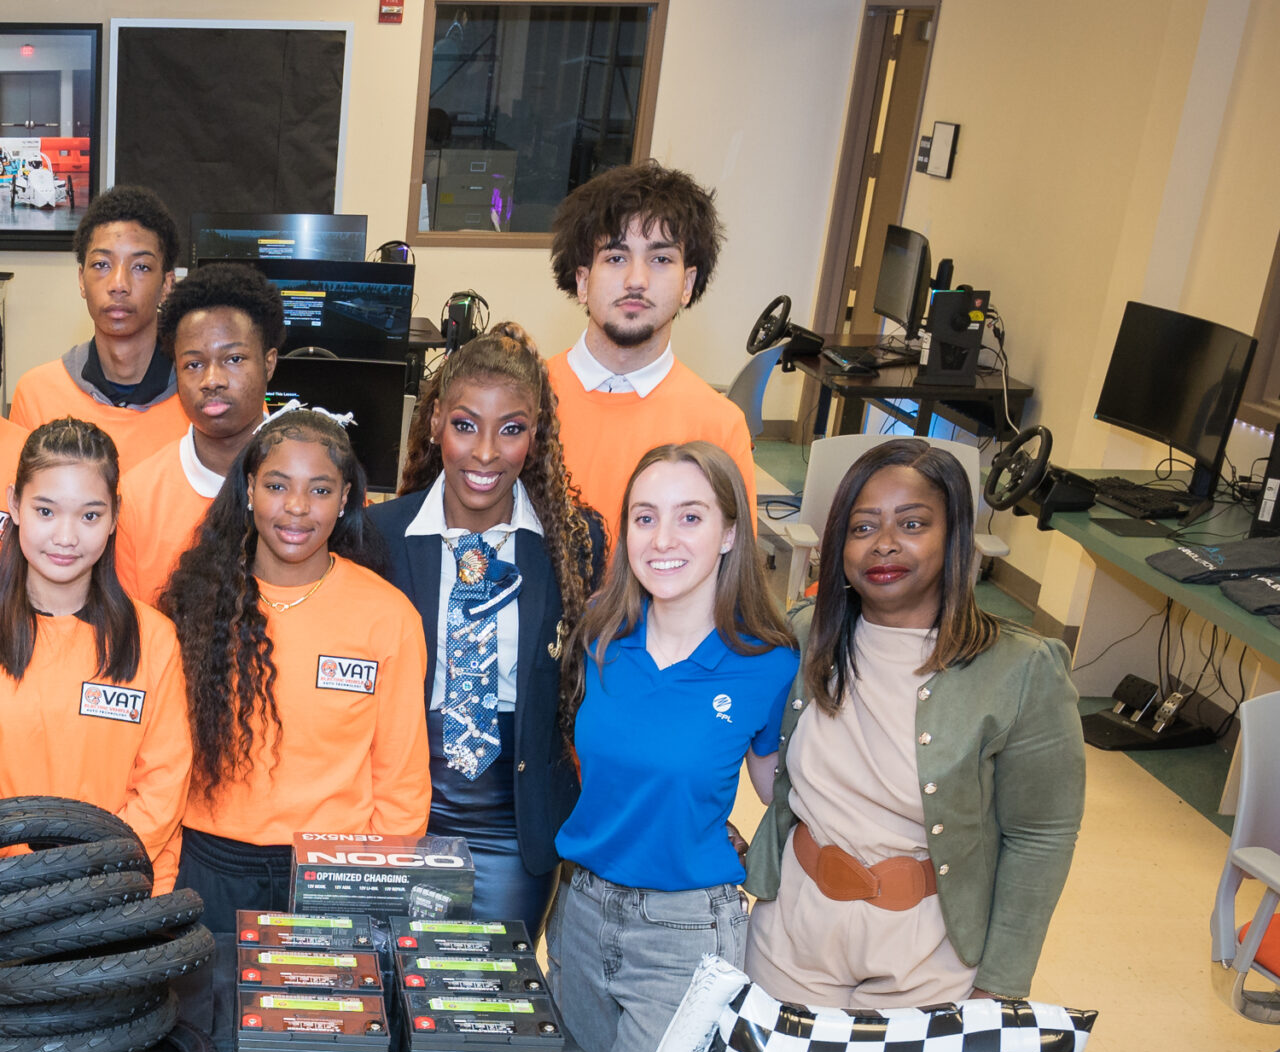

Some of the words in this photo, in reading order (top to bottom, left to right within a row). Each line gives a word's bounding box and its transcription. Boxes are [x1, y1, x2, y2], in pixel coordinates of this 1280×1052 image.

[338, 662, 374, 680] VAT
[103, 690, 141, 710] VAT
[716, 712, 733, 723] FPL
[302, 833, 384, 842] GEN5X3
[307, 852, 464, 868] NOCO
[317, 872, 361, 882] OPTIMIZED
